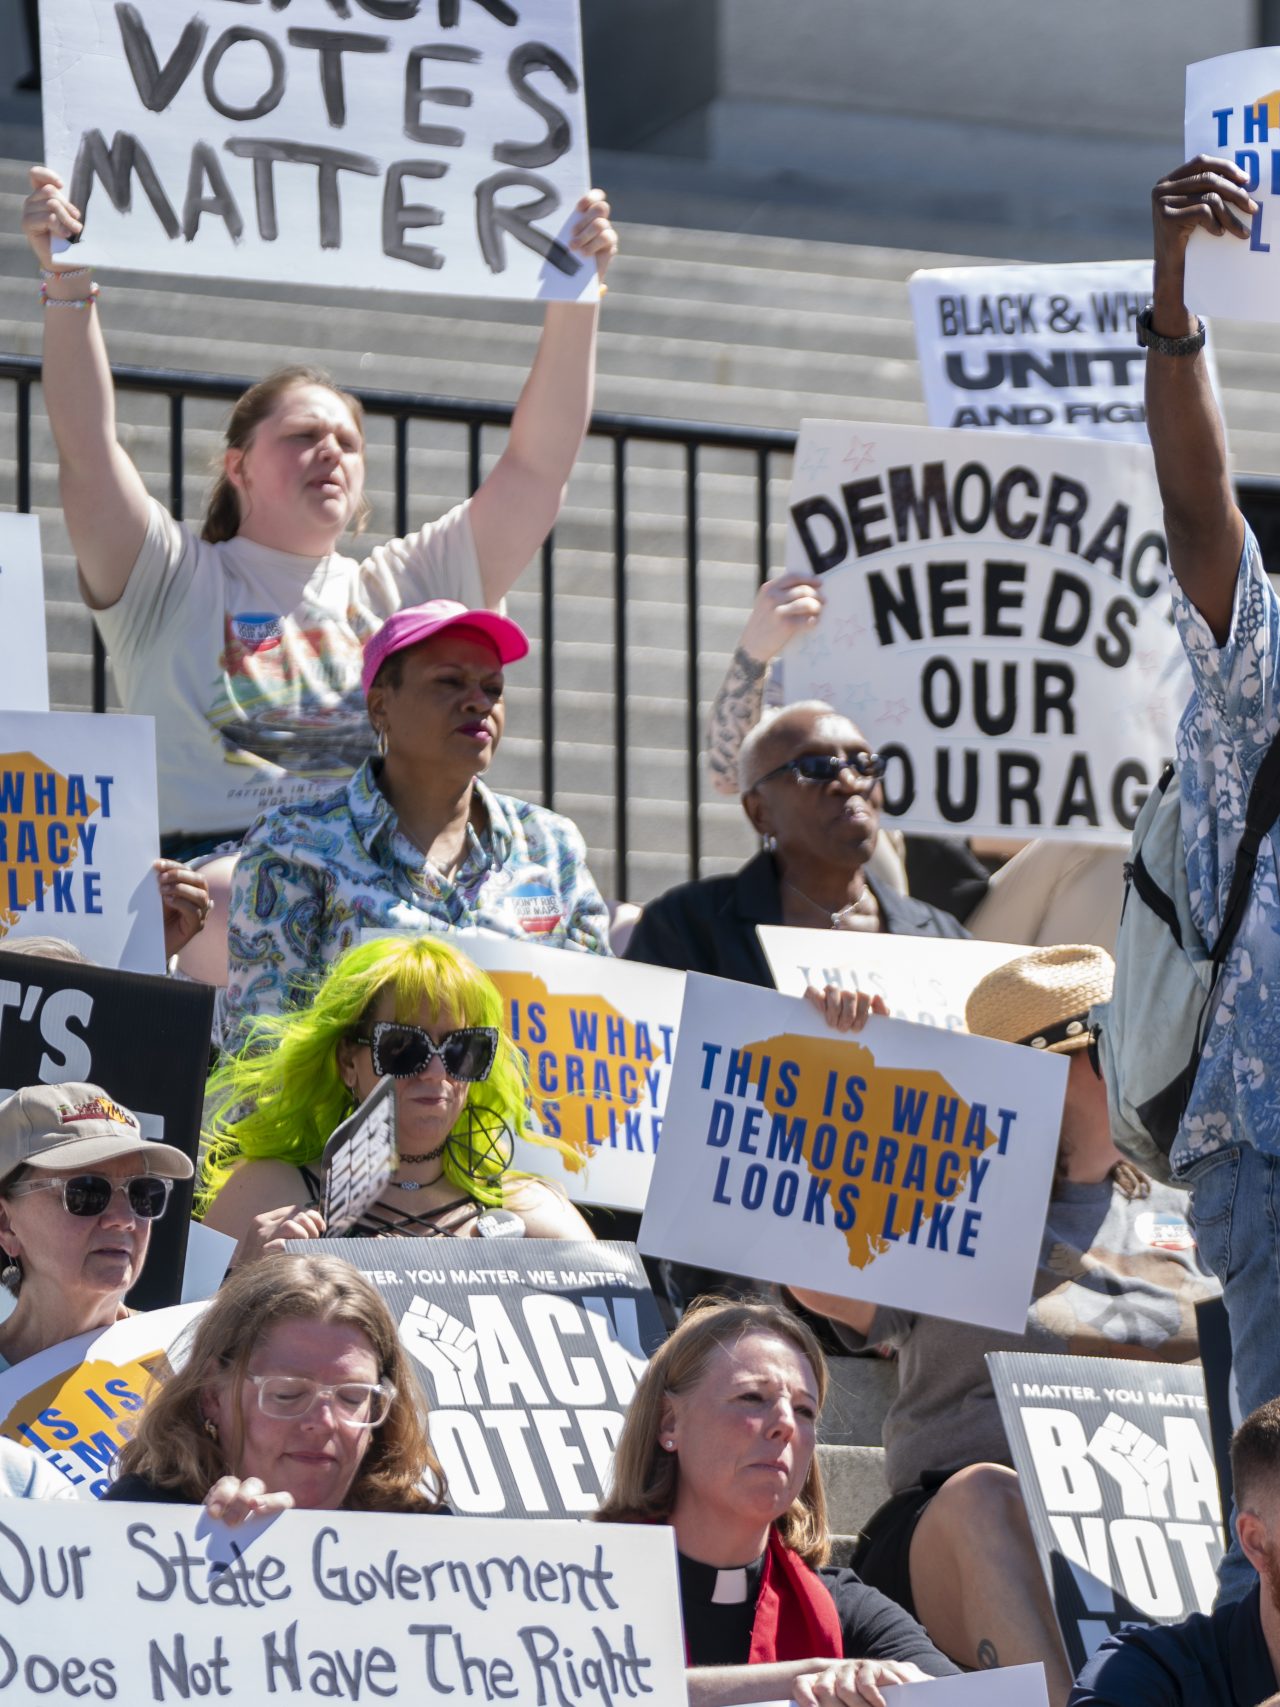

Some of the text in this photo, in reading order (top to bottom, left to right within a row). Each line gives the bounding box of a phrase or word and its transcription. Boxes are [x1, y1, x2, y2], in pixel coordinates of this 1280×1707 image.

[115, 3, 577, 168] VOTES
[68, 128, 583, 275] MATTER
[939, 295, 1037, 336] BLACK
[1050, 295, 1083, 334] &
[946, 351, 1146, 389] UNIT
[953, 403, 1145, 427] AND FIG
[791, 461, 1168, 598] DEMOCRAC
[867, 561, 1137, 668] NEEDS
[921, 655, 1075, 736] OUR
[878, 743, 1150, 829] OURAG
[8, 869, 103, 914] LIKE
[510, 998, 675, 1064] IS WHAT
[701, 1042, 1017, 1156] THIS IS WHAT
[706, 1098, 990, 1203] DEMOCRACY
[712, 1156, 982, 1258] LOOKS LIKE
[406, 1270, 446, 1285] YOU
[450, 1270, 525, 1285] MATTER.
[527, 1271, 556, 1285] WE
[561, 1271, 633, 1287] MATTER.
[17, 1408, 79, 1454] IS
[84, 1379, 145, 1420] IS
[1012, 1383, 1208, 1409] I MATTER. YOU MATTE
[127, 1523, 291, 1607] State
[312, 1527, 619, 1611] Government
[149, 1633, 232, 1702] Not
[262, 1619, 398, 1701] Have
[408, 1624, 519, 1701] The
[517, 1624, 653, 1707] Right
